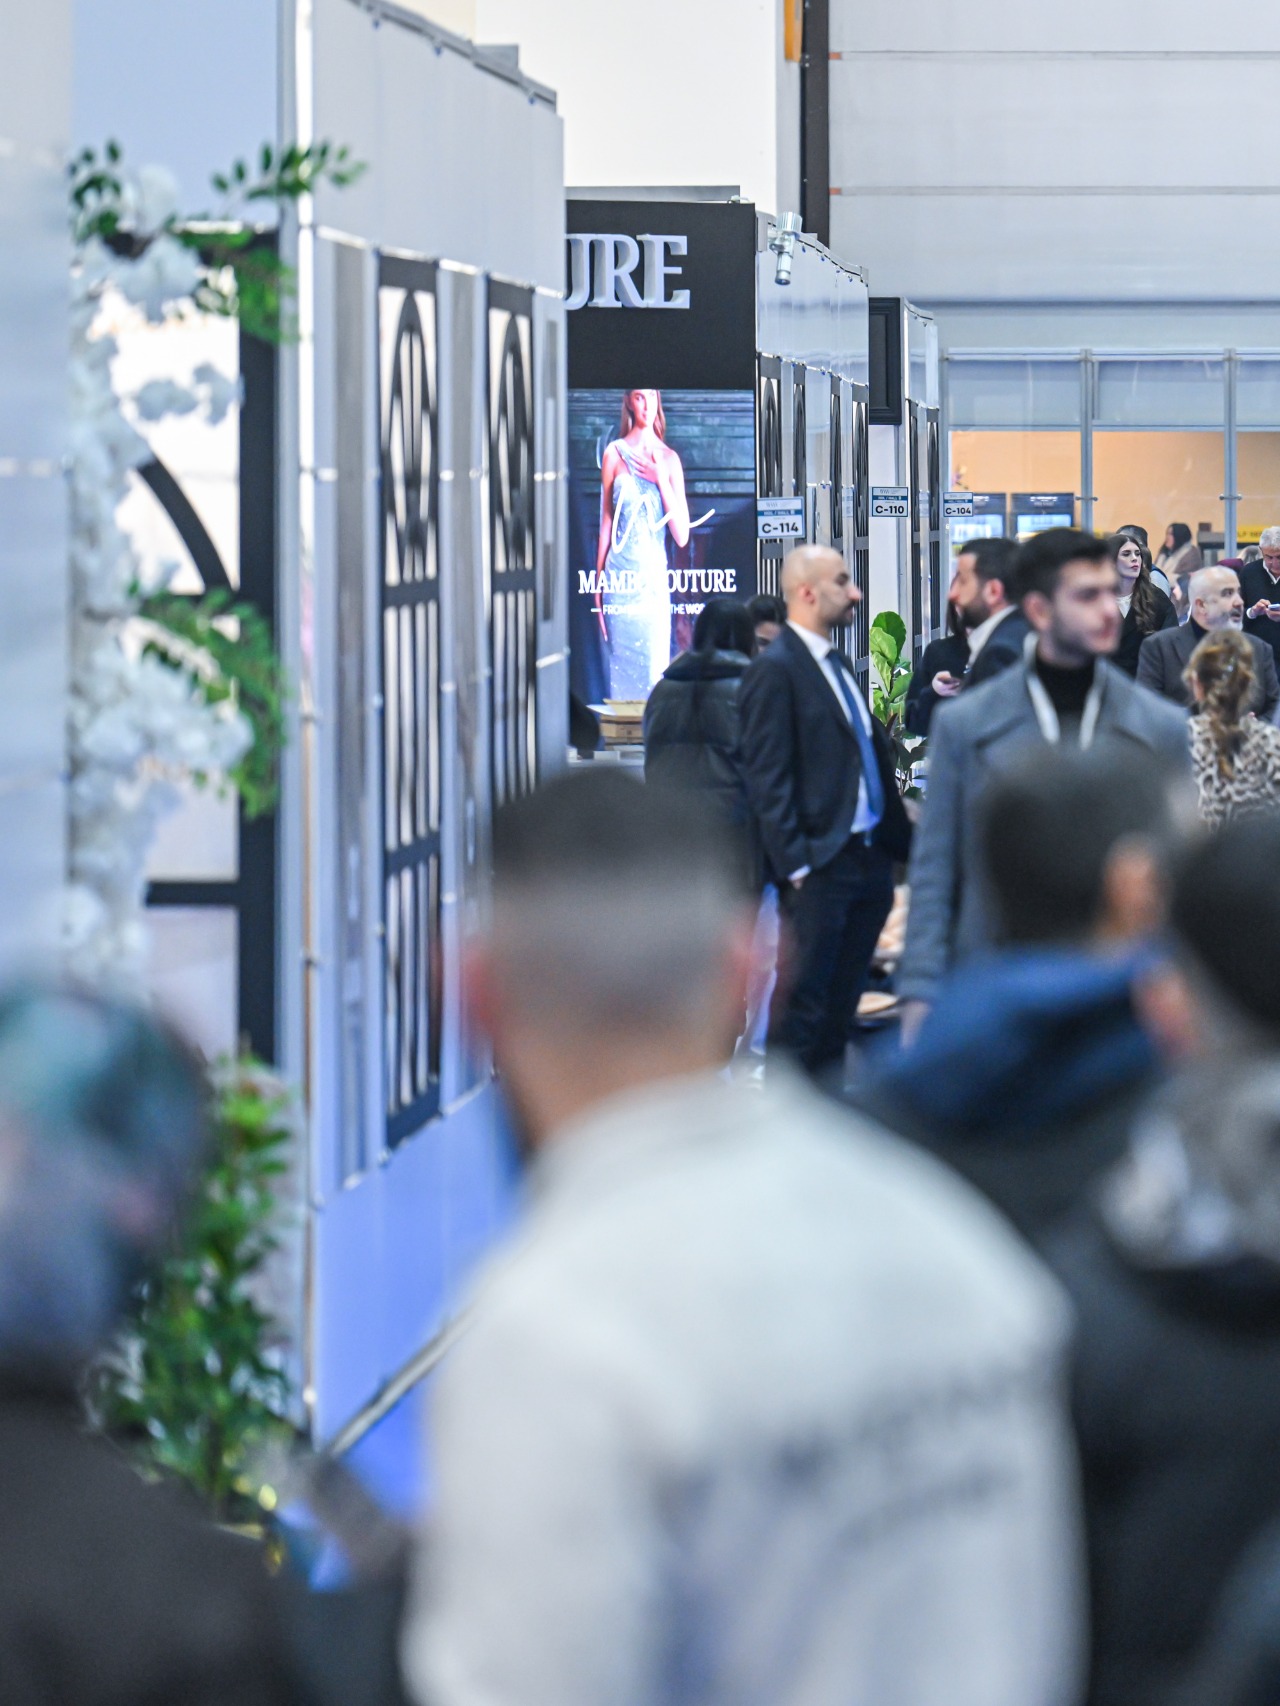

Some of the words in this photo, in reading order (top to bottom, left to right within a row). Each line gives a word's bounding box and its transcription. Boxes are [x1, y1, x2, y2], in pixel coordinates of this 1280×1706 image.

[875, 505, 904, 514] C-110
[762, 522, 799, 534] C-114
[578, 570, 649, 594] MAMB
[658, 569, 737, 593] OUTURE
